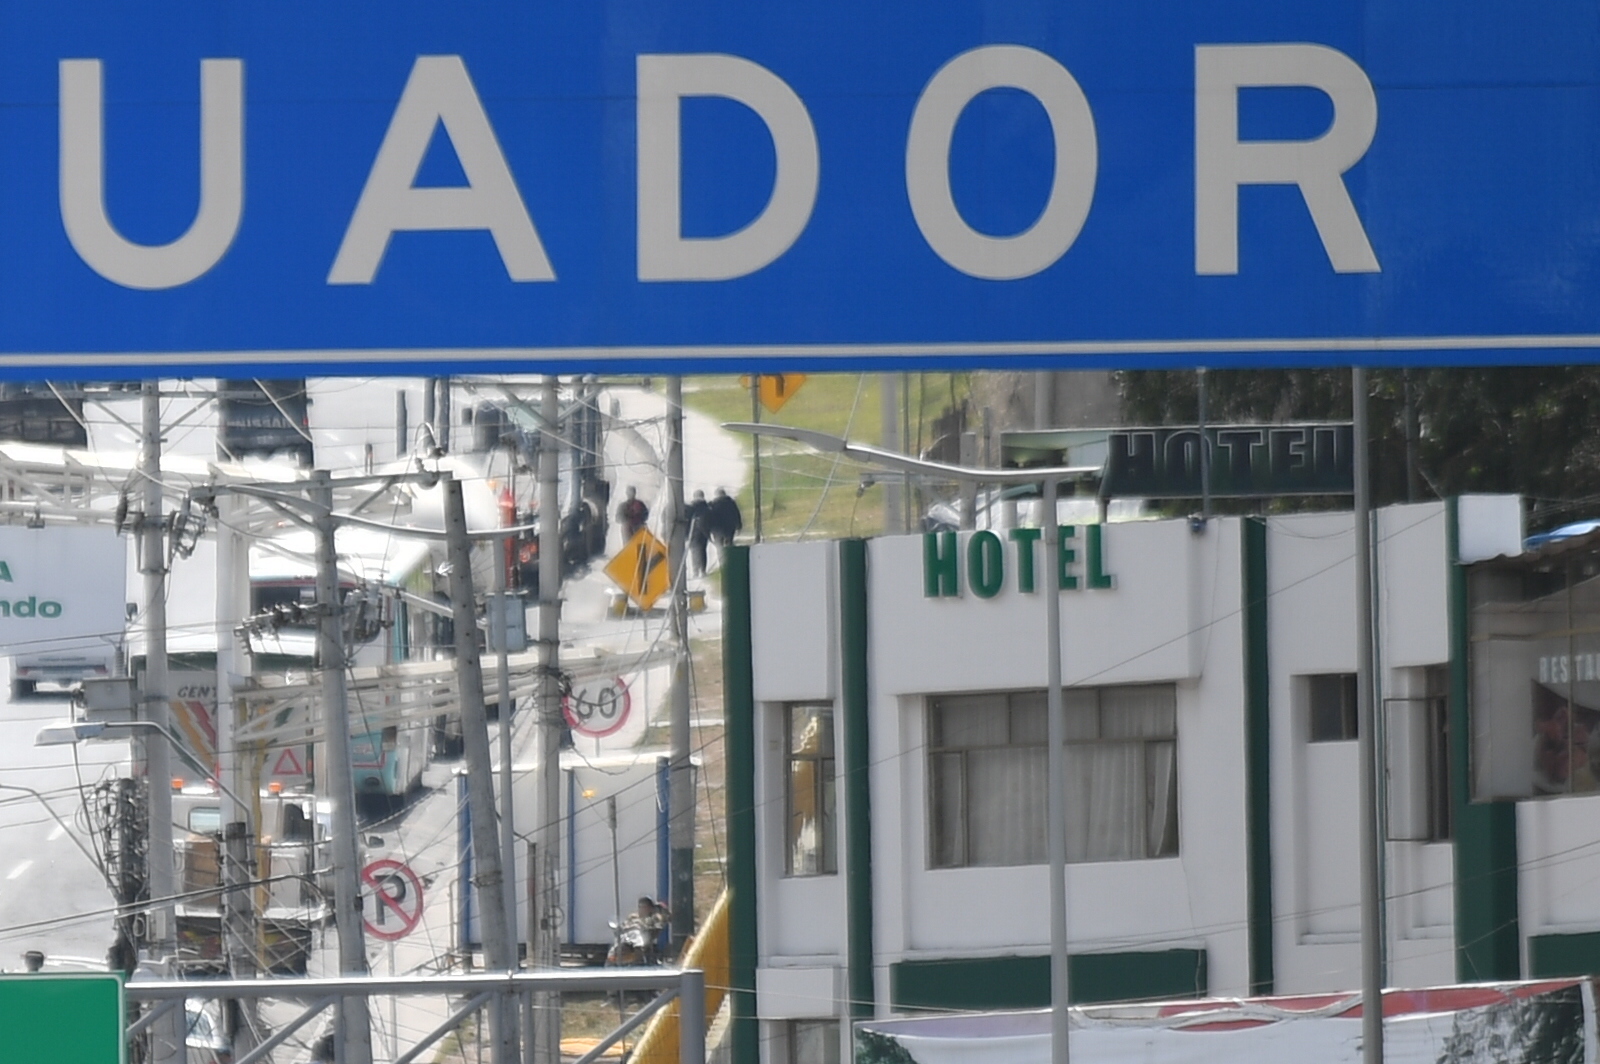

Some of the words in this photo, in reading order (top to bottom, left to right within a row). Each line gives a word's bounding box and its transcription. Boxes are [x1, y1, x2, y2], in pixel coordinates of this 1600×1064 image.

[922, 524, 1114, 599] HOTEL
[1539, 653, 1600, 684] RESTA
[573, 686, 619, 722] 60
[374, 873, 408, 928] P
